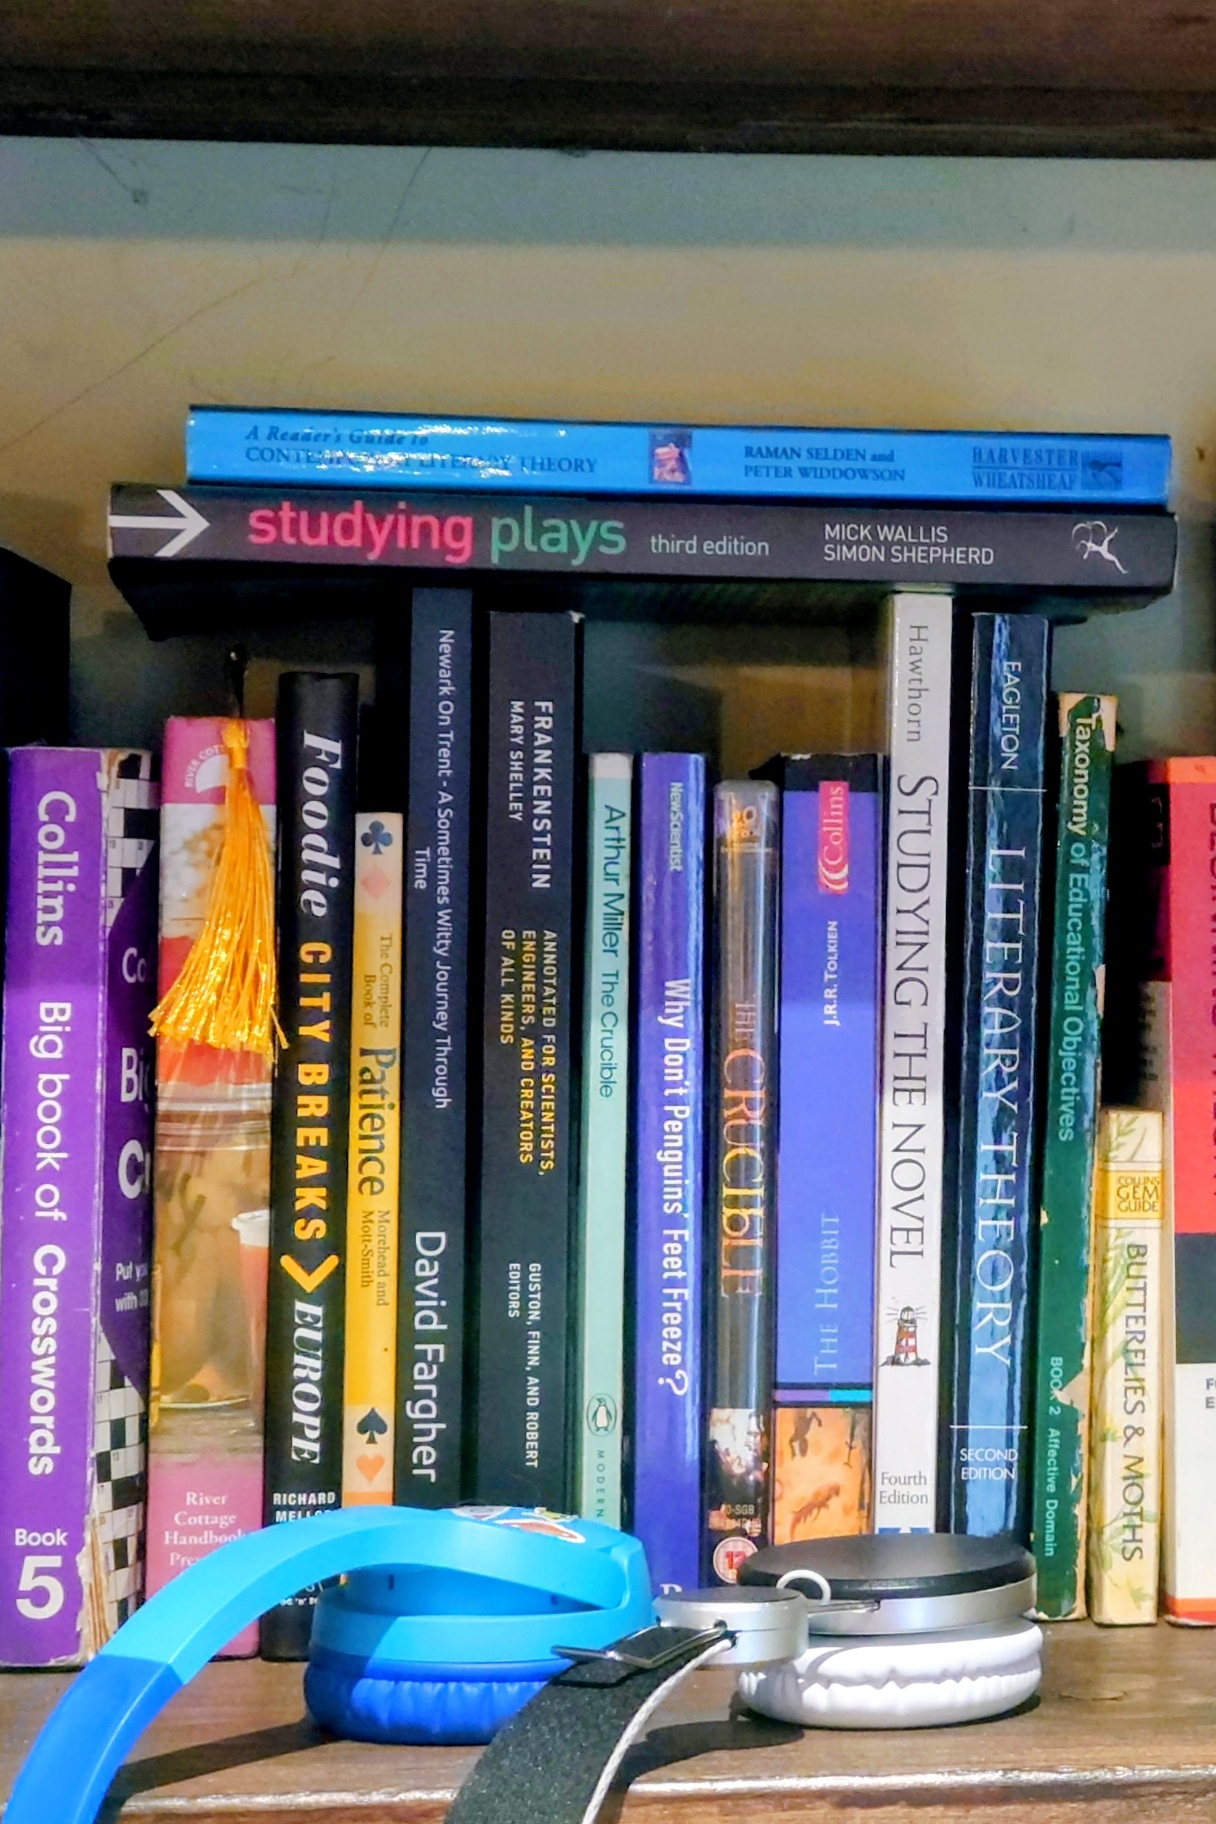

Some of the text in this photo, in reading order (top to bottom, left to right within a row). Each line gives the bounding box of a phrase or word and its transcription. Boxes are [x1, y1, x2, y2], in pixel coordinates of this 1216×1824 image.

[744, 446, 895, 462] RAMAN SELDEN and
[744, 464, 906, 482] PETER WIDDOWSON
[972, 445, 1079, 466] HARVESTER
[972, 470, 1077, 491] WHEATSHEAF
[248, 502, 770, 565] studying plays third edition
[824, 523, 949, 543] MICK WALLIS
[824, 544, 995, 566] SIMON SHEPHERD
[905, 624, 929, 743] Hawthorn
[1001, 660, 1022, 771] EAGLETON
[508, 700, 524, 821] MARY SHELLEY
[532, 700, 554, 889] FRANKENSTEIN
[415, 848, 431, 889] Time
[431, 629, 455, 1109] Newark On Trent A Sometimes Witty Journey Through
[600, 805, 627, 1098] Arthur Miller The Crucible
[1057, 717, 1097, 1141] Taxonomy of Educational Objectives
[519, 929, 536, 1164] ENGINEERS, AND CREATORS
[538, 929, 558, 1176] ANNOTATED FOR SCIENTISTS,
[889, 774, 940, 1269] STUDYING THE NOVEL
[292, 729, 343, 1465] Foodie CITY BREAKS EUROPE
[357, 1047, 398, 1196] Patience
[975, 847, 1026, 1369] LITERARY THEORY
[28, 791, 77, 1477] Collins Big book of Crosswords
[1116, 1185, 1160, 1200] GEM
[1117, 1200, 1160, 1213] GUIDE
[508, 1262, 521, 1318] EDITORS
[814, 1212, 840, 1376] THE HOBBIT
[407, 1231, 448, 1483] David Fargher
[1121, 1243, 1149, 1563] BUTTERFLIES & MOTHS
[596, 1450, 606, 1518] MODERN
[881, 1471, 928, 1486] Fourth
[960, 1448, 1019, 1462] SECOND
[961, 1466, 1016, 1481] EDITION
[174, 1510, 236, 1528] Cottage
[186, 1491, 228, 1506] River
[273, 1491, 336, 1505] RICHARD
[879, 1489, 929, 1505] Edition
[15, 1527, 69, 1546] Book
[16, 1554, 65, 1620] 5
